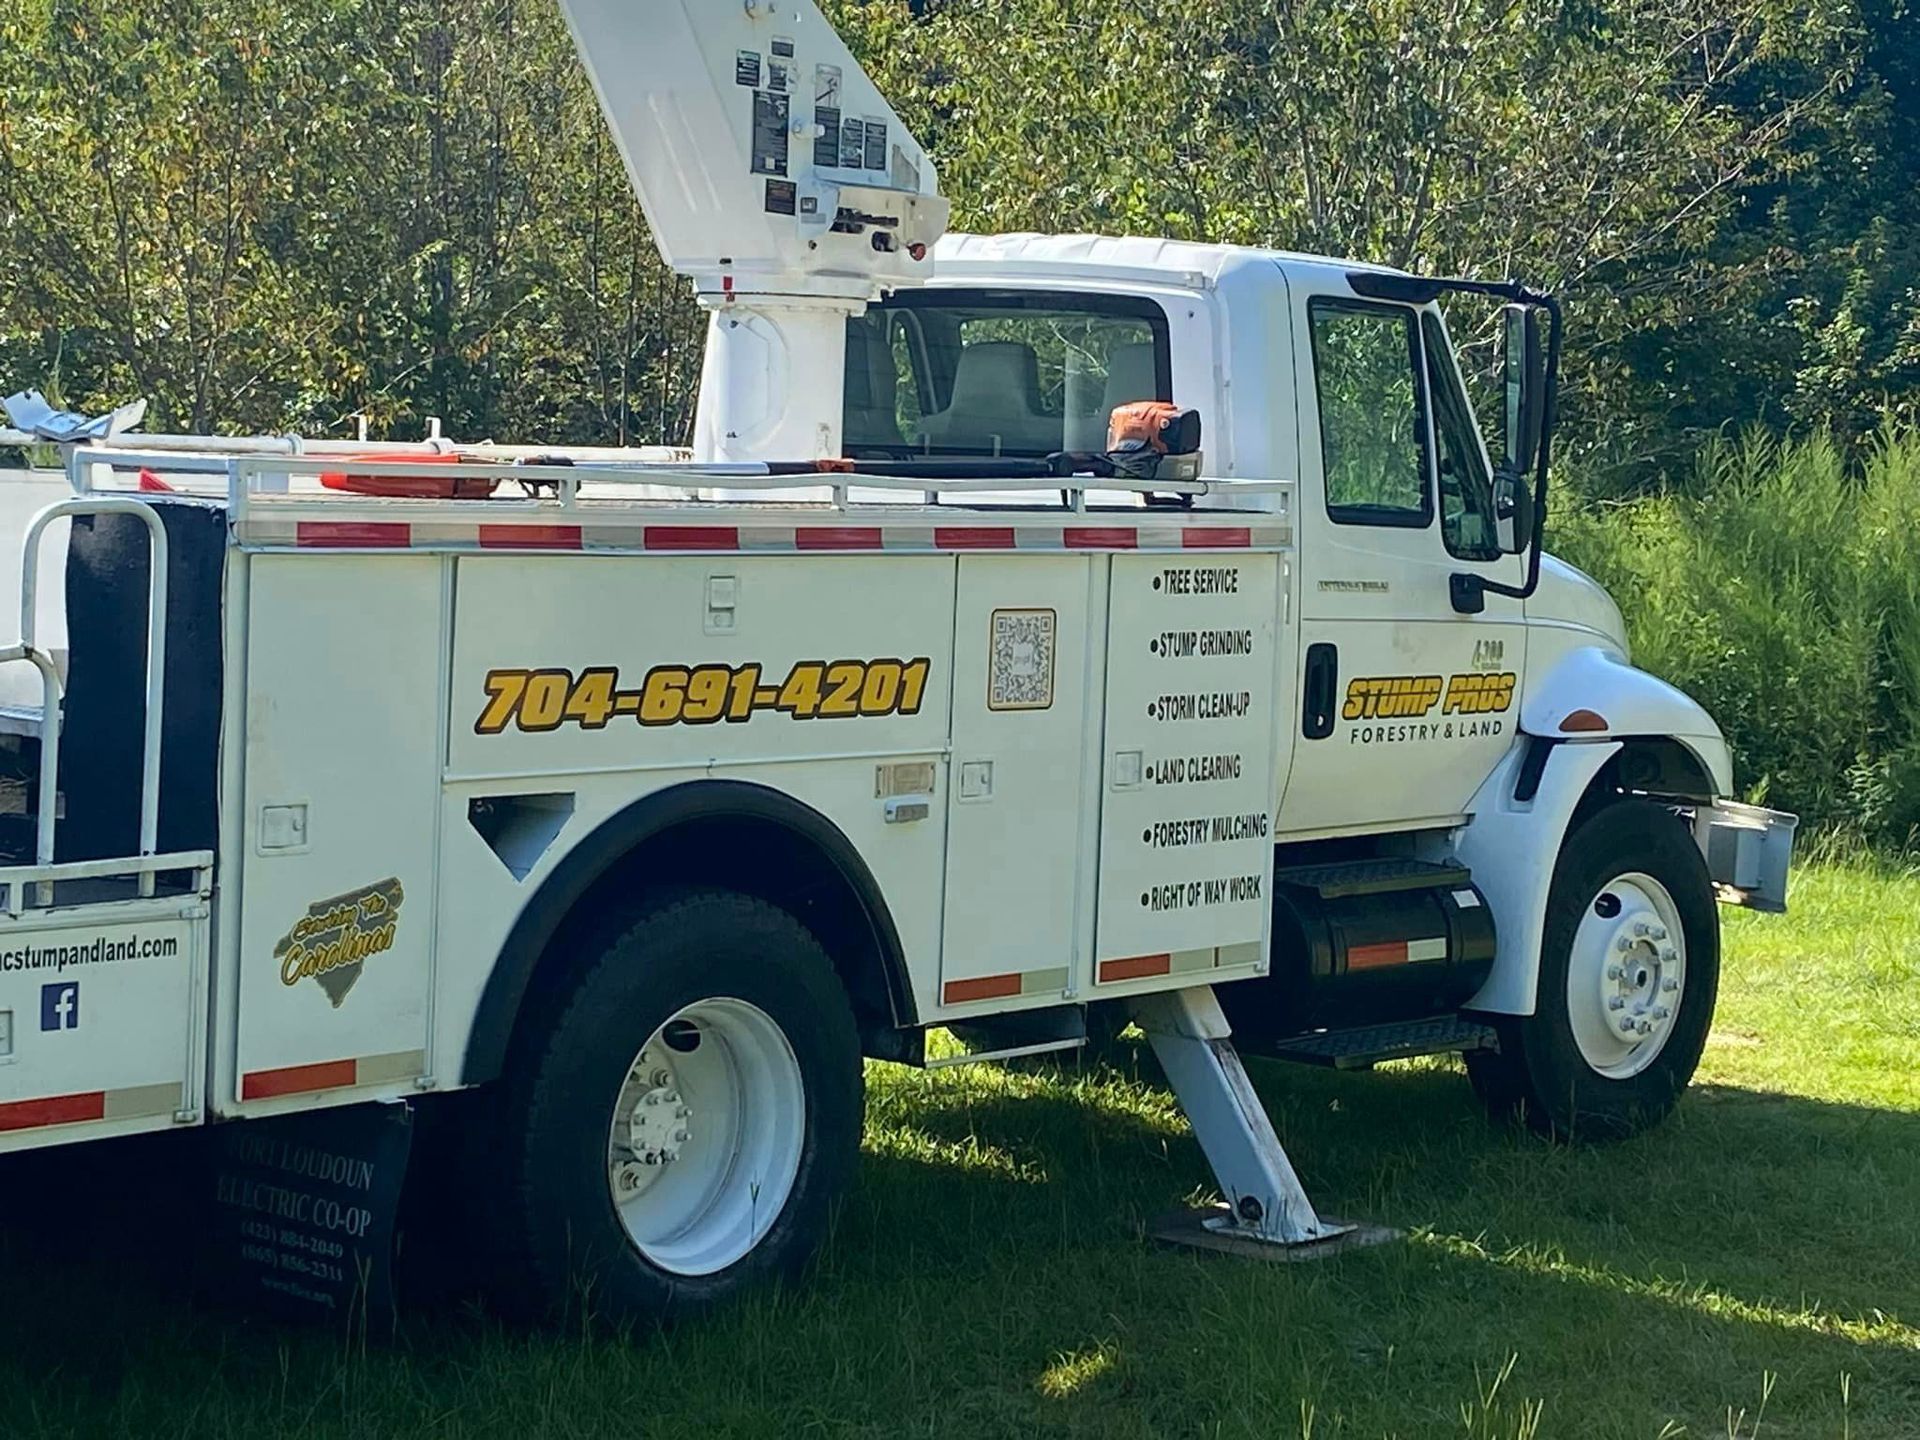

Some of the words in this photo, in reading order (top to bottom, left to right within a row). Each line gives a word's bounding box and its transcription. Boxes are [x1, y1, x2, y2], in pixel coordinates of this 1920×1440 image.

[1163, 569, 1191, 594] TREE
[1193, 568, 1238, 594] SERVICE
[1160, 632, 1197, 657] STUMP
[1200, 630, 1252, 656] GRINDING
[474, 657, 930, 734] 704-691-4201
[1157, 694, 1195, 721] STORM
[1198, 692, 1250, 719] CLEAN-UP
[1341, 675, 1443, 720] STUMP
[1442, 672, 1516, 715] PROS
[1351, 723, 1440, 744] FORESTRY
[1443, 722, 1453, 738] &
[1459, 721, 1503, 738] LAND
[1156, 758, 1185, 784] LAND
[1188, 754, 1241, 782] CLEARING
[1153, 819, 1209, 849] FORESTRY
[1212, 813, 1267, 842] MULCHING
[1151, 883, 1185, 911] RIGHT
[1187, 882, 1201, 907] OF
[1204, 879, 1227, 905] WAY
[1230, 875, 1262, 902] WORK
[281, 923, 396, 986] Carolinas
[280, 1142, 374, 1191] LOUDOUN
[217, 1175, 311, 1222] ELECTRIC
[313, 1198, 373, 1238] CO-OP
